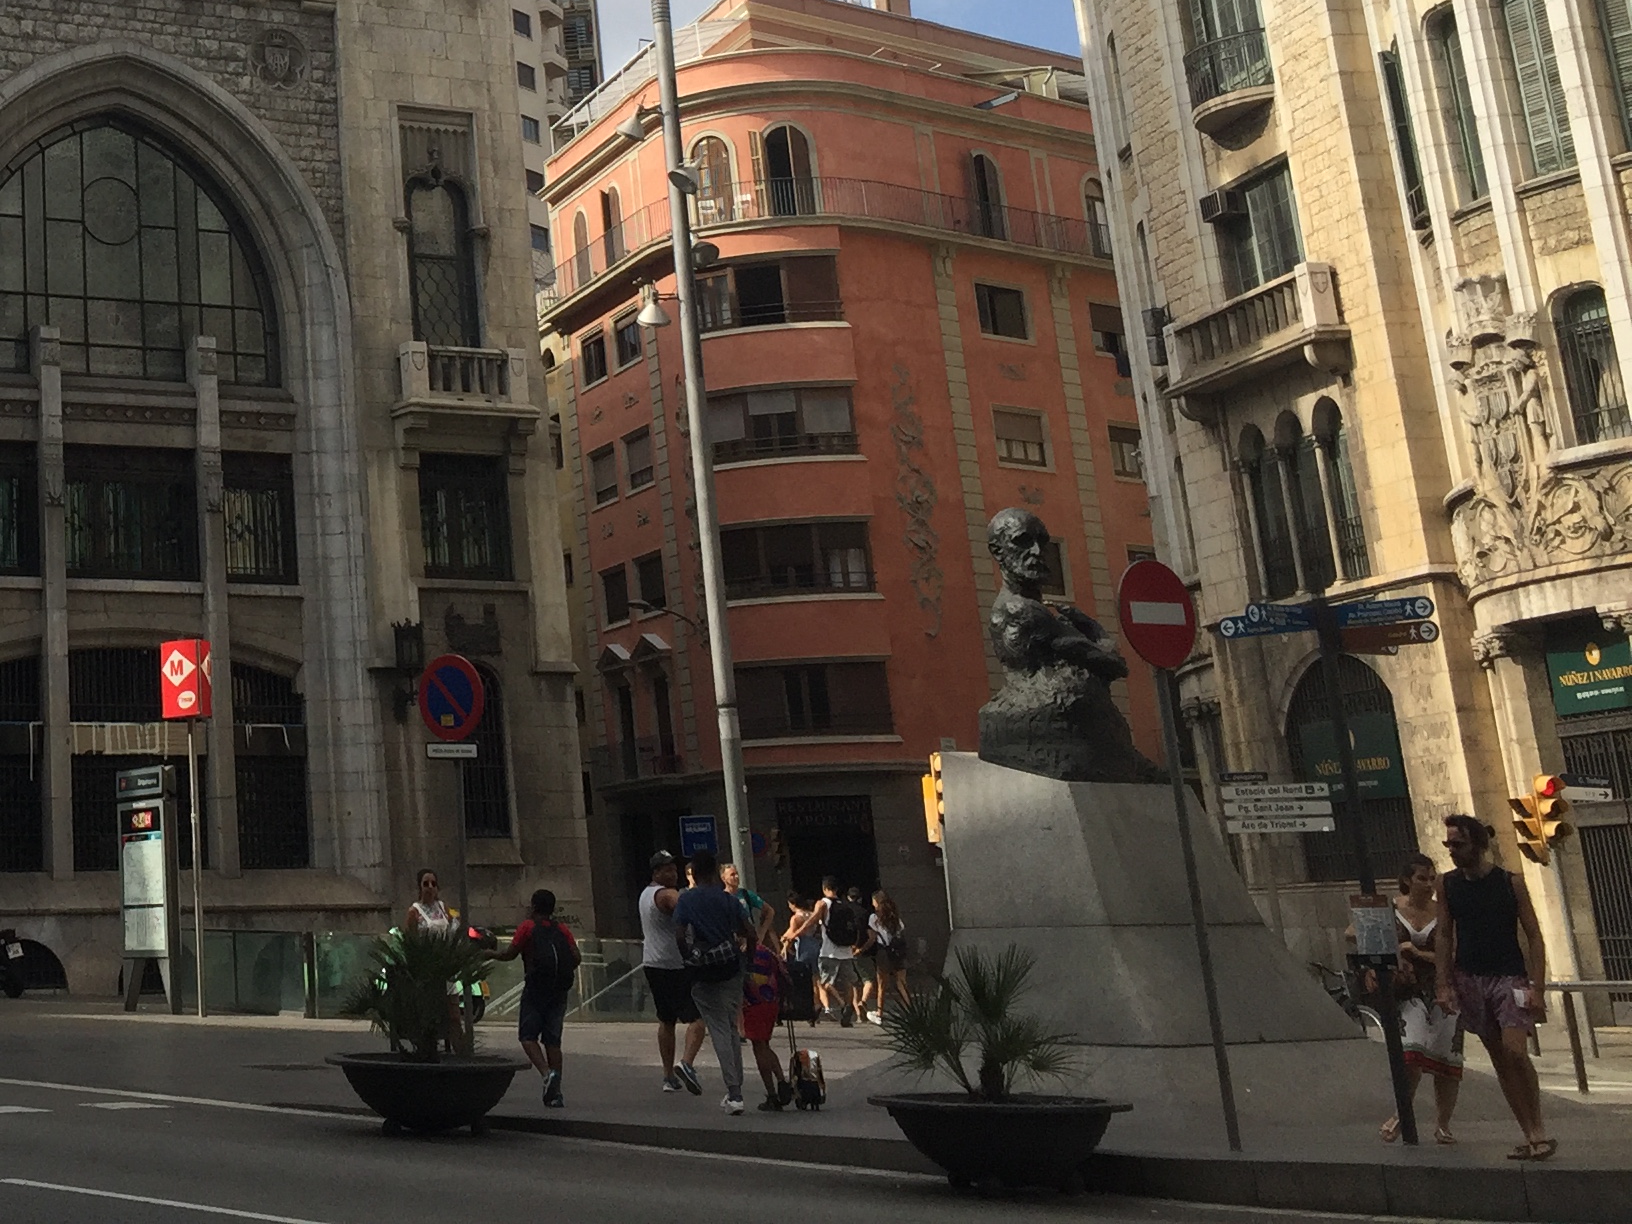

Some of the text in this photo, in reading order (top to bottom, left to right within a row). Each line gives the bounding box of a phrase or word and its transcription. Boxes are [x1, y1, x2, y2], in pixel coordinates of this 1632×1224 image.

[170, 659, 184, 676] M
[1559, 670, 1589, 686] NÚÑEZ
[1315, 757, 1390, 776] NÚÑE AVARRO
[1268, 786, 1280, 794] del
[1283, 785, 1302, 794] Nord
[1254, 804, 1272, 812] Sant
[1242, 821, 1298, 829] Arc de Triomf
